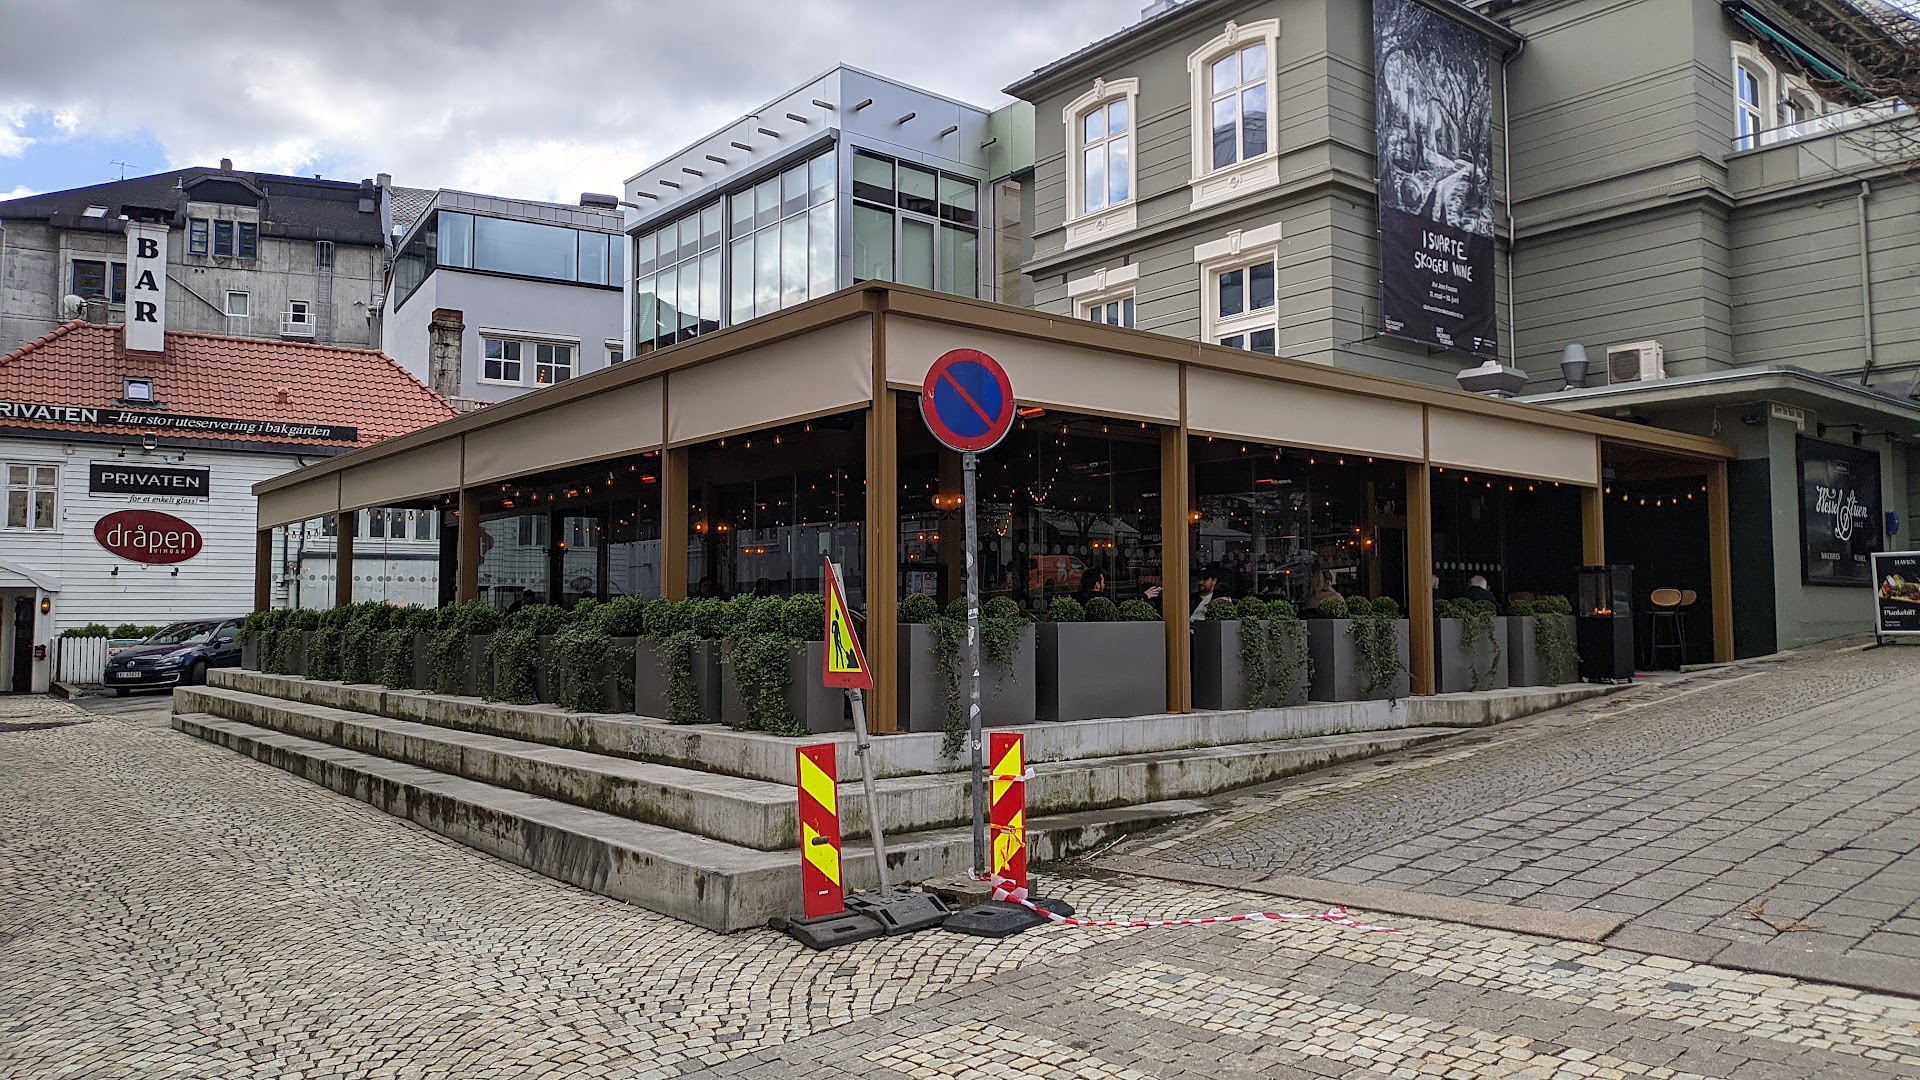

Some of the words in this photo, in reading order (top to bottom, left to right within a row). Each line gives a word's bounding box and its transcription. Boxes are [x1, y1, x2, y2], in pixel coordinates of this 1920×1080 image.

[1422, 230, 1427, 249] I
[1428, 231, 1468, 260] SVARTE
[1414, 251, 1449, 275] SKOGEN
[134, 237, 160, 323] BAR
[146, 415, 175, 426] stor
[175, 418, 257, 433] uteservering
[258, 422, 264, 432] i
[264, 422, 331, 437] bakgården
[101, 472, 199, 488] PRIVATEN
[128, 494, 141, 504] for
[152, 495, 175, 503] enkelt
[106, 523, 195, 554] dråpen
